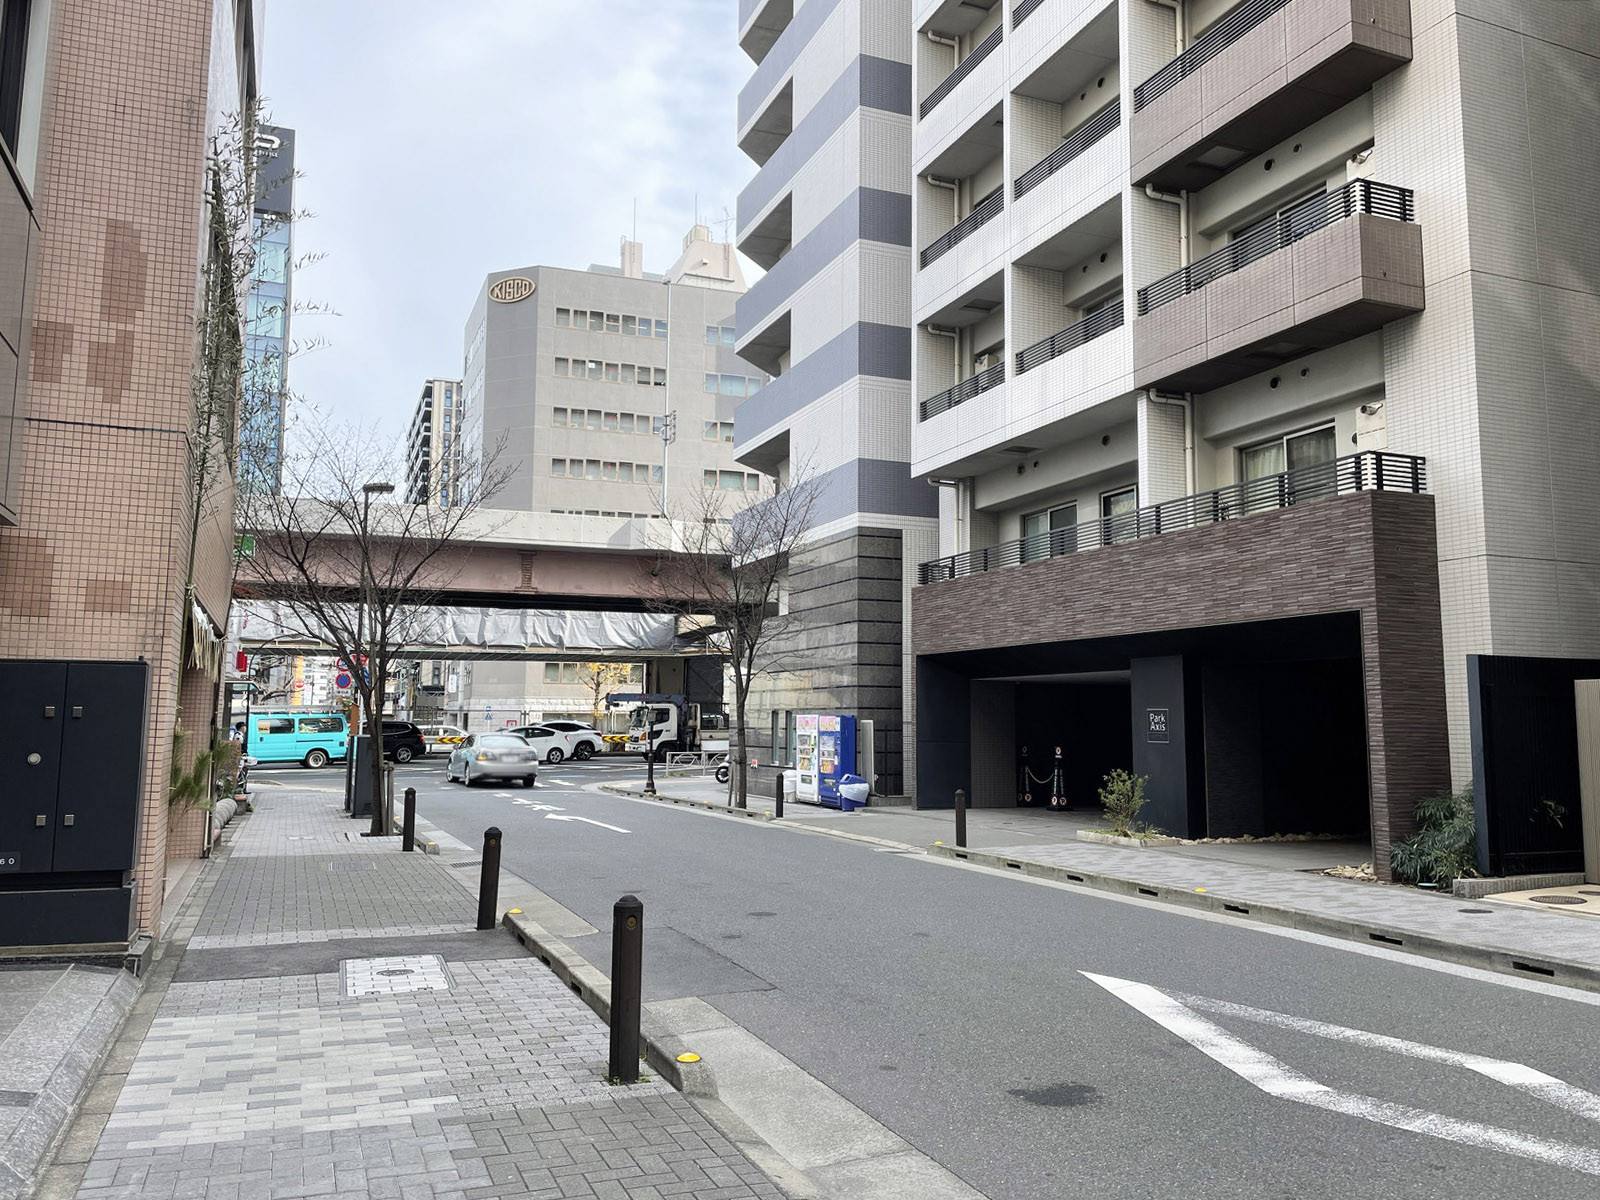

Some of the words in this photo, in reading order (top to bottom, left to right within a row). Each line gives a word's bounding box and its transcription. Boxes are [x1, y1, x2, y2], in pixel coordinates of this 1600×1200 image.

[494, 279, 530, 300] KISCO
[1149, 713, 1166, 723] Park
[1149, 721, 1166, 731] Axis
